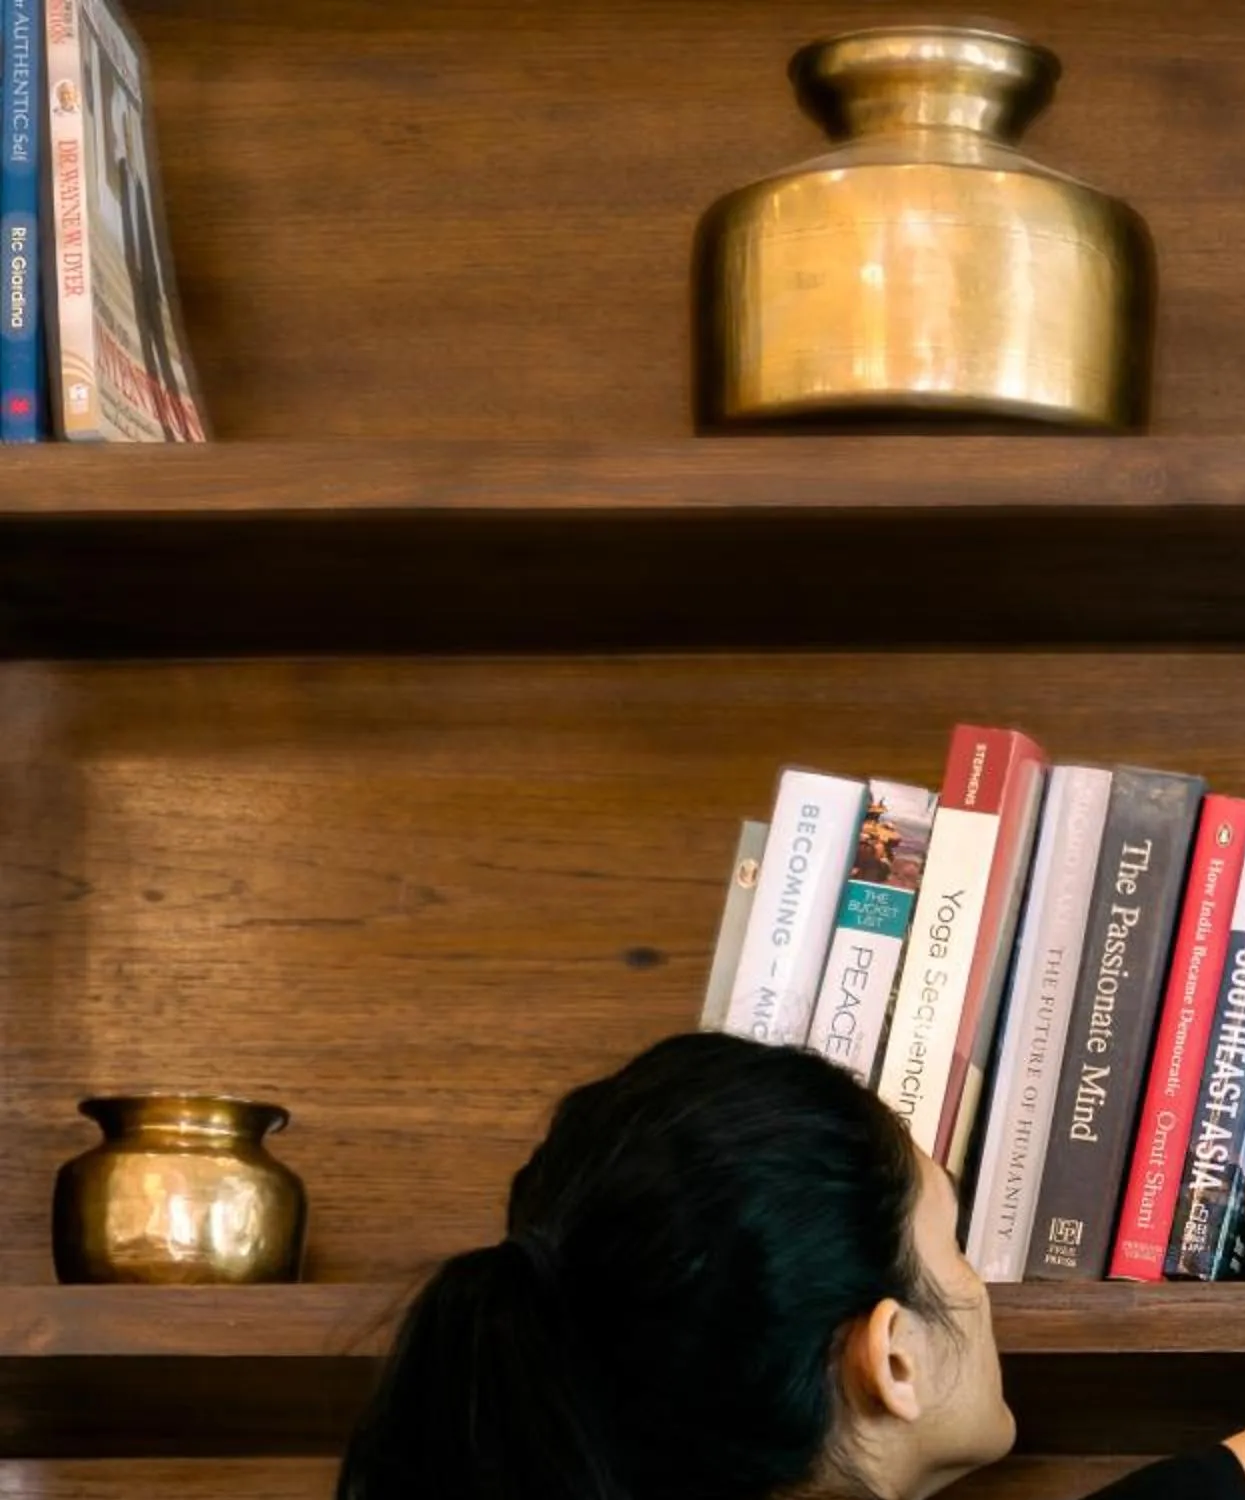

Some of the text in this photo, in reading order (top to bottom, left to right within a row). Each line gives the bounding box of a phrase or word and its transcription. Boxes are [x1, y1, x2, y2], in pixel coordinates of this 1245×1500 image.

[10, 14, 30, 163] AUTHENTIC Self
[11, 227, 27, 329] Ric Giardina
[964, 743, 987, 806] STEPHENS
[771, 803, 820, 948] BECOMING
[847, 899, 899, 918] BUCKET
[863, 890, 889, 903] THE
[929, 890, 965, 960] Yoga
[825, 944, 873, 1055] PEACE
[1069, 839, 1153, 1143] The Passionate Mind
[1164, 858, 1225, 1098] How India Became Democratic
[996, 947, 1064, 1240] THE FUTURE OF HUMANITY
[1136, 1109, 1178, 1229] Ornit Shani
[1188, 1119, 1234, 1200] ASIA
